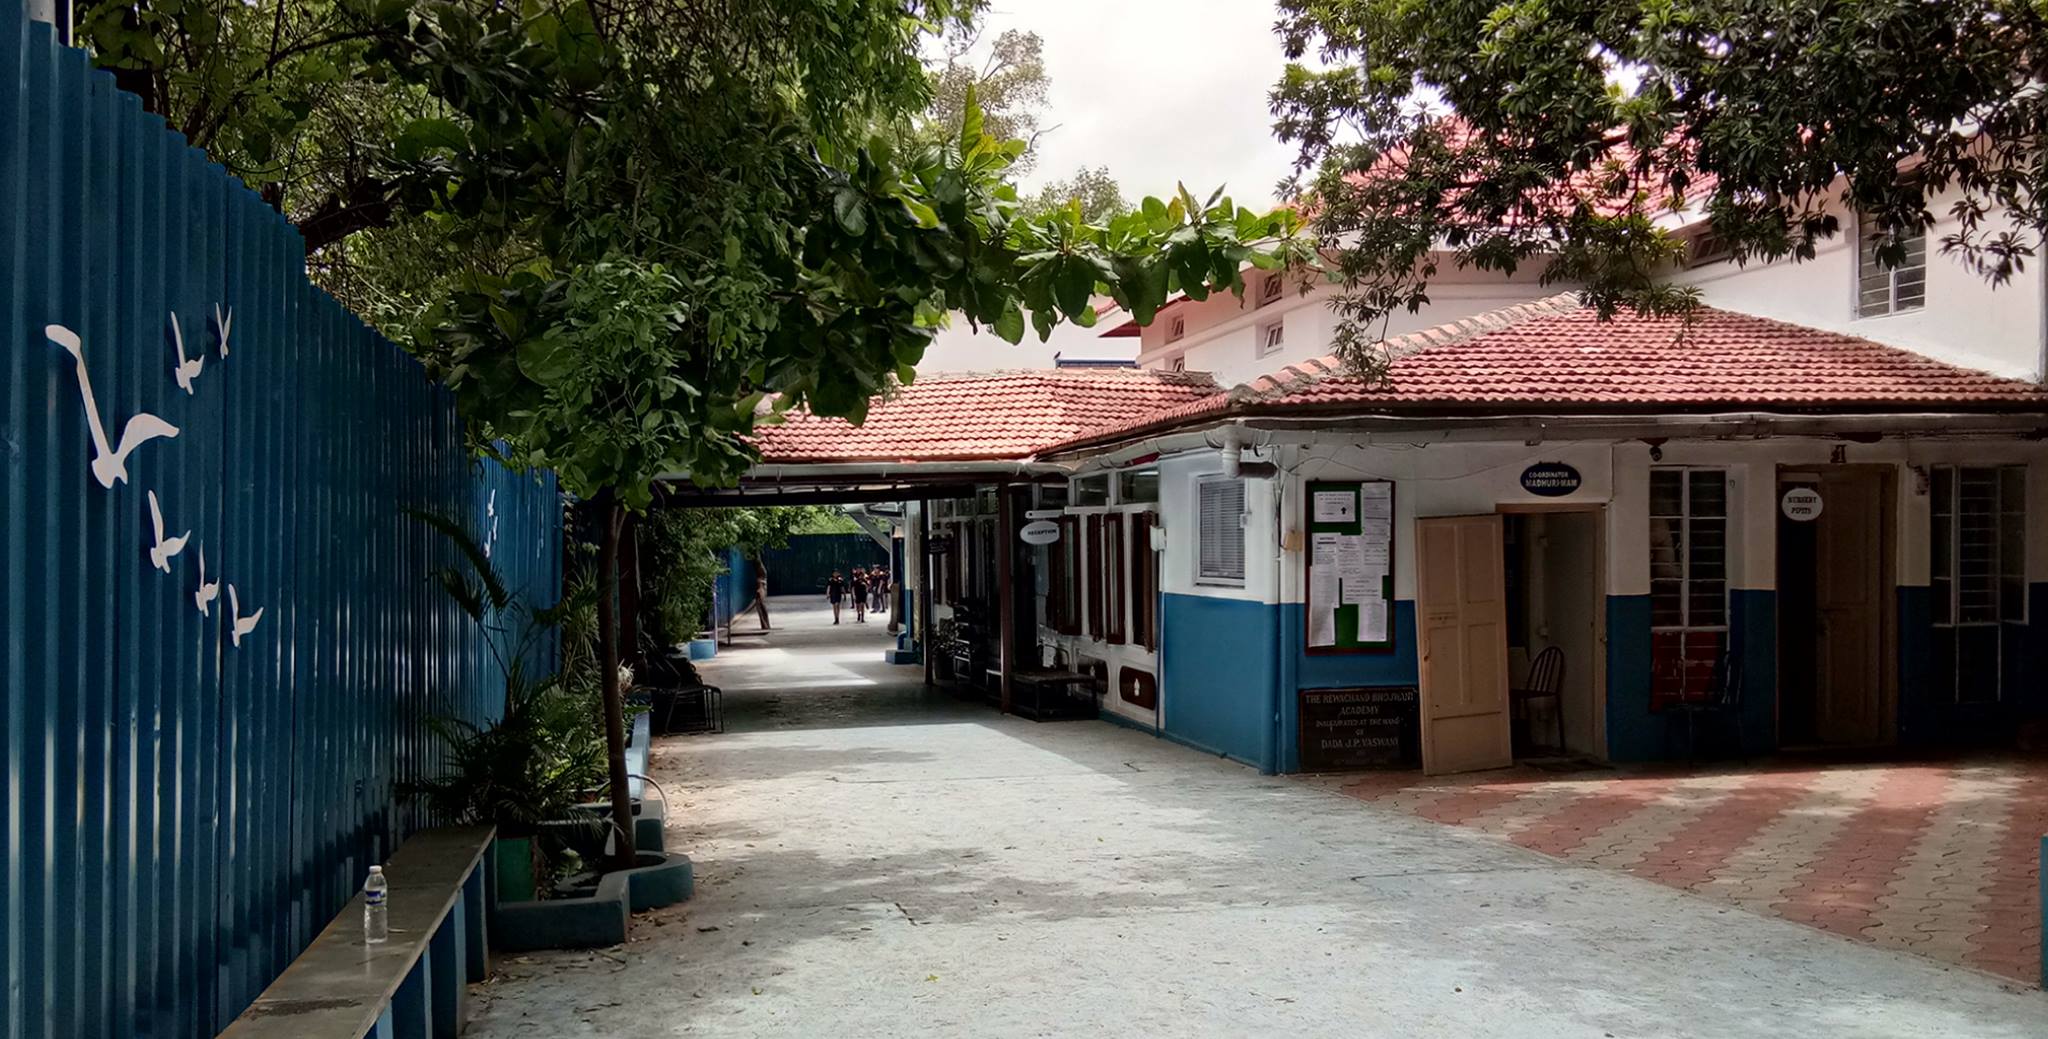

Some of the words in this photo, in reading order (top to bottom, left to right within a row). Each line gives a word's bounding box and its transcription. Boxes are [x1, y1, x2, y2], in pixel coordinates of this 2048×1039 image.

[1305, 694, 1321, 704] THE
[1341, 705, 1379, 715] ACADEMY
[1321, 738, 1343, 749] DADA
